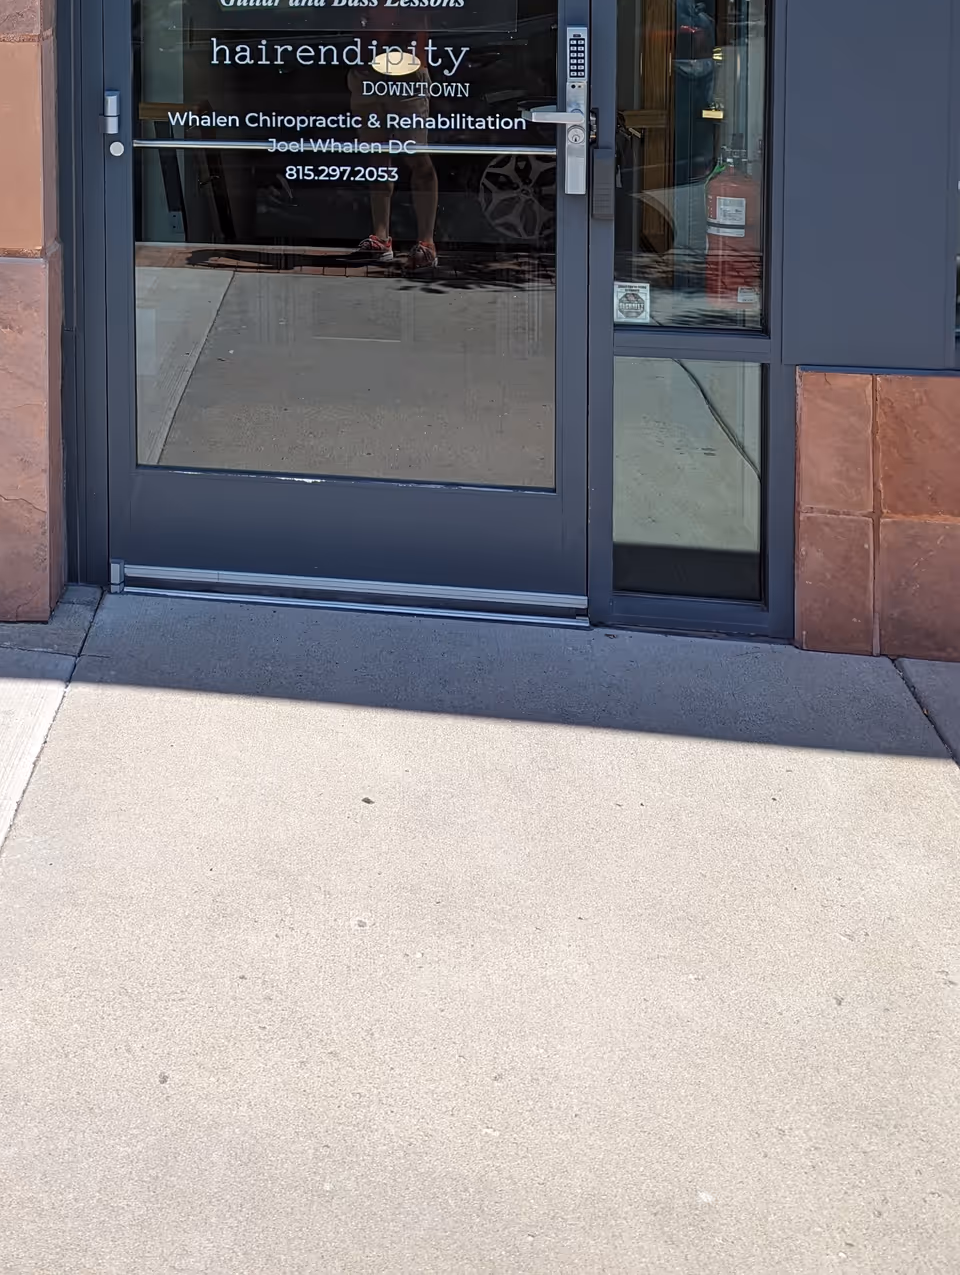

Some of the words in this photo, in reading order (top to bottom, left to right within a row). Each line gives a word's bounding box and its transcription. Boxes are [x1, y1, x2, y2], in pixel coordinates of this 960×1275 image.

[210, 37, 470, 76] hairendipity
[361, 80, 471, 98] DOWNTOWN
[167, 111, 240, 128] Whalen
[244, 112, 363, 131] Chiropractic
[367, 113, 381, 129] &
[386, 113, 527, 131] Rehabilitation
[267, 137, 306, 153] Joel
[309, 137, 383, 154] Whalen
[387, 139, 418, 155] DC
[284, 165, 399, 182] 815.297.2053
